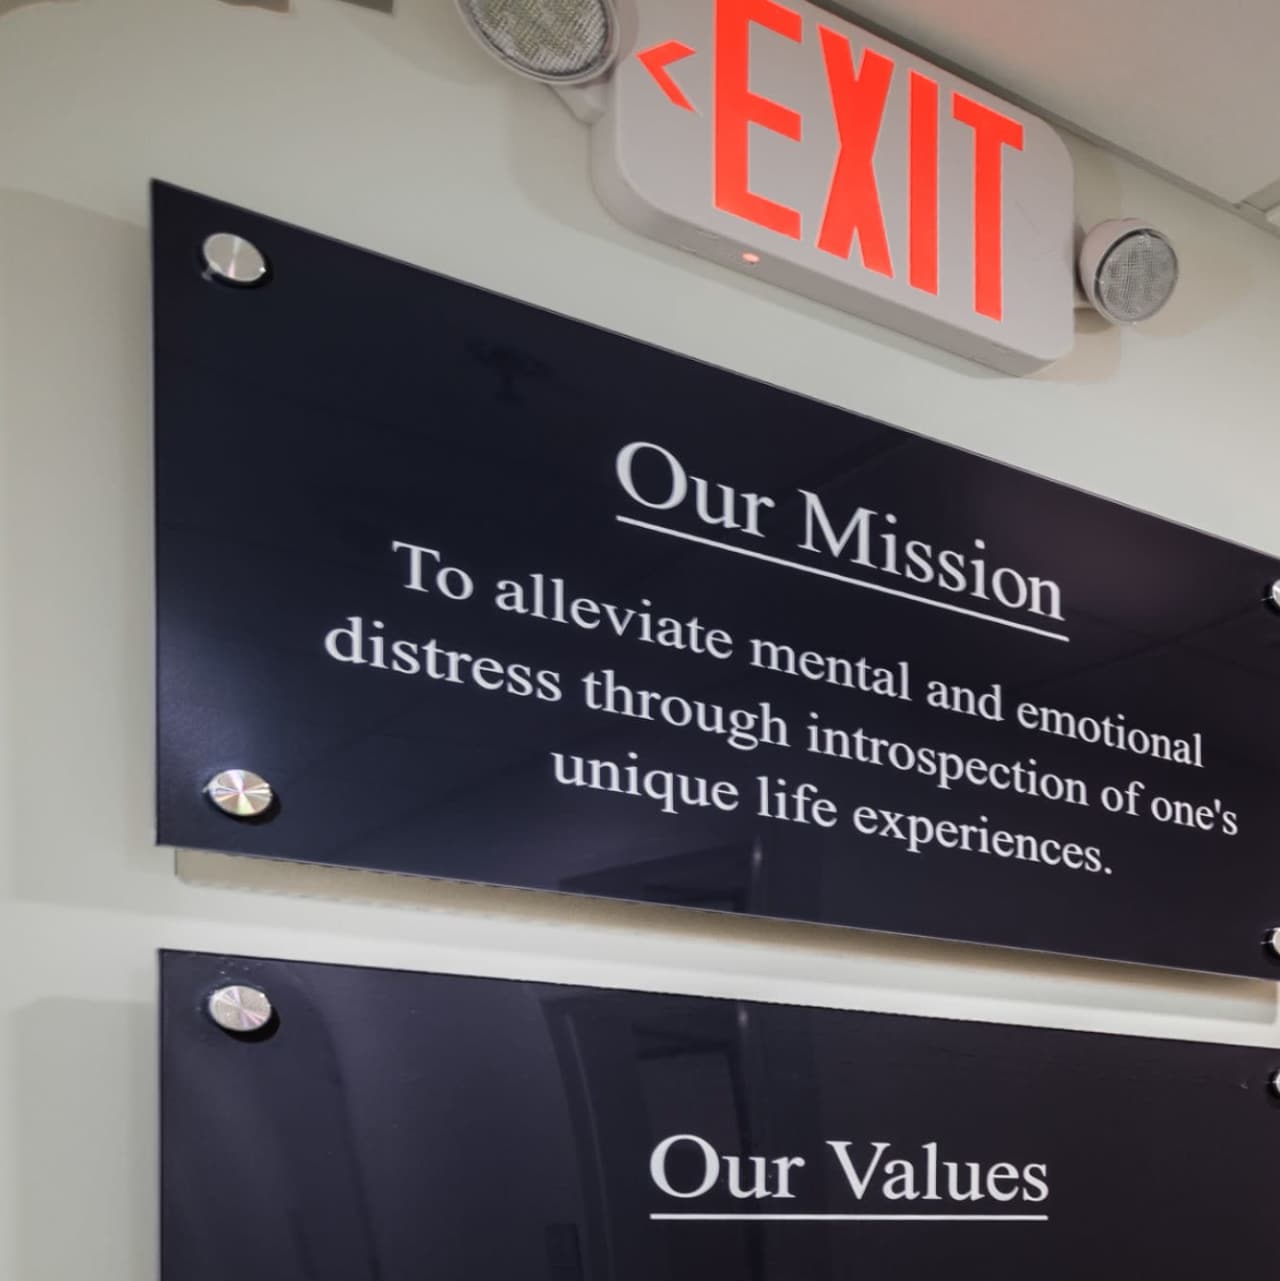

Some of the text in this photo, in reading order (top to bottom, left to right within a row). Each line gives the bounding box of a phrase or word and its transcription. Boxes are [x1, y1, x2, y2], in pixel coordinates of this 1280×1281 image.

[713, 0, 1024, 323] EXIT
[615, 441, 1065, 622] Our Mission
[324, 615, 1238, 836] distress through introspection of one's
[391, 540, 1204, 768] To alleviate mental and emotional
[550, 751, 1113, 875] unique life experiences.
[649, 1133, 1049, 1202] Our Values
